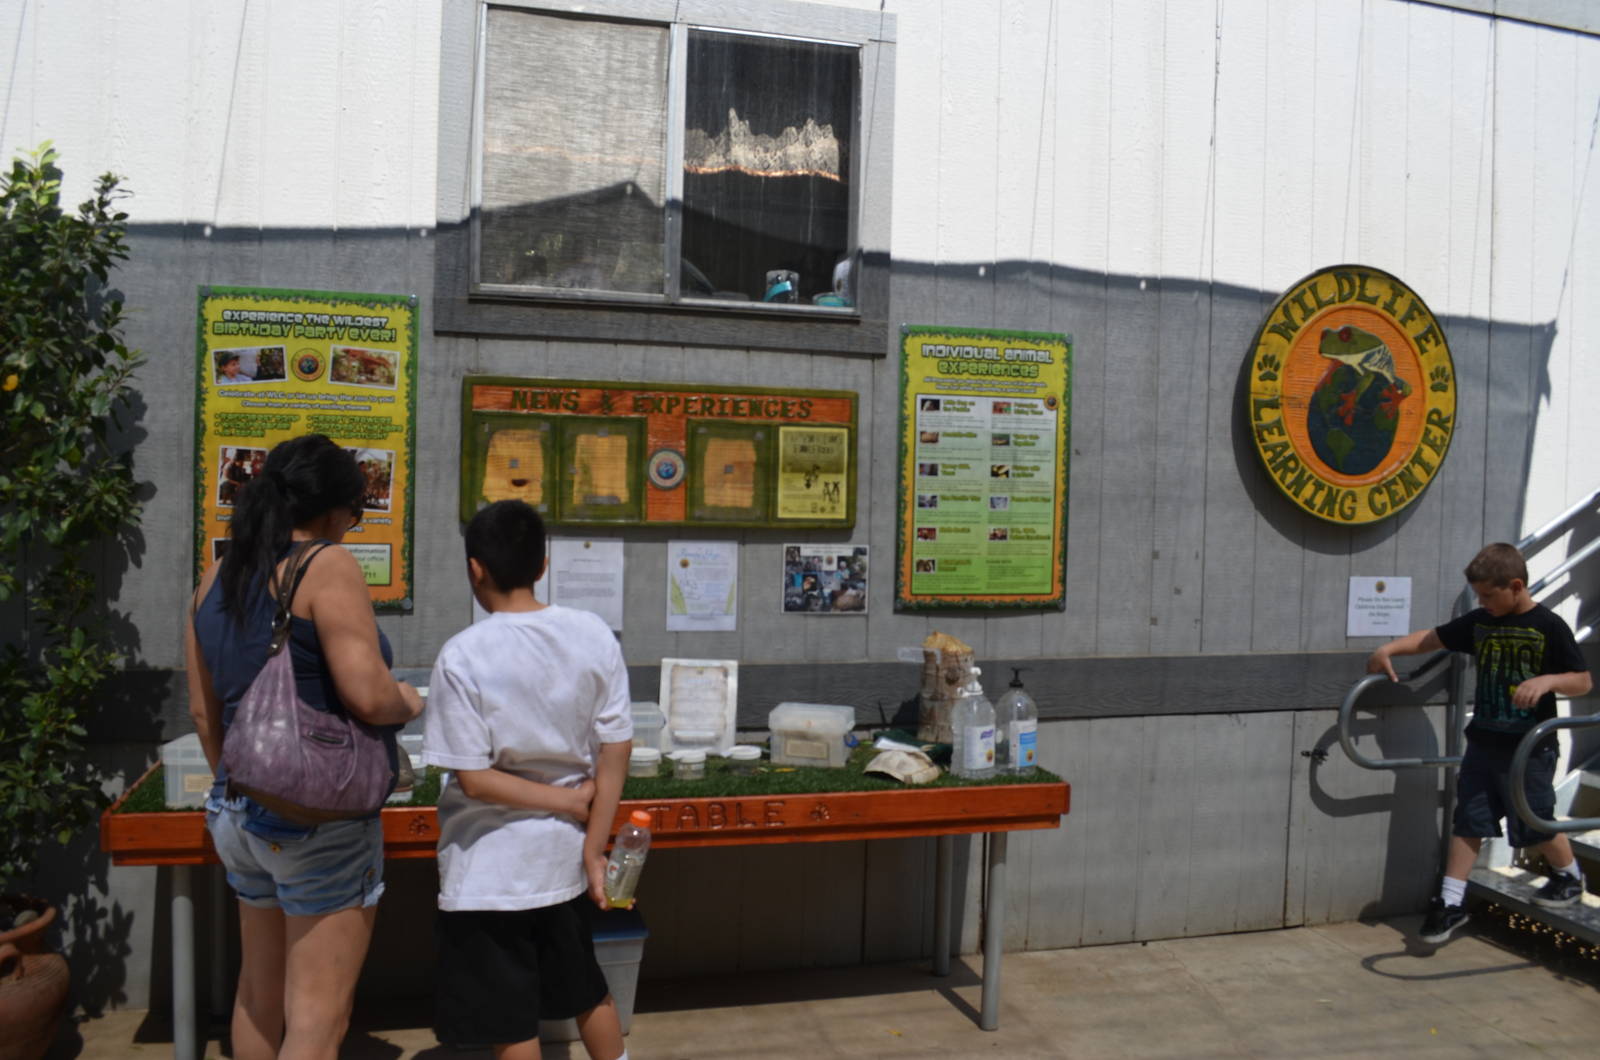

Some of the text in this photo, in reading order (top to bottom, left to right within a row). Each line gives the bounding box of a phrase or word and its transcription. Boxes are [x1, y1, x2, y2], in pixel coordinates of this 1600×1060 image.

[1267, 272, 1441, 355] WILDLIFE
[213, 322, 293, 337] BIRTHDAY
[294, 324, 346, 339] PARTY
[938, 360, 1039, 378] EXPERIENCES
[511, 389, 814, 419] NEWS & EXPERIENCES
[1253, 397, 1451, 520] LEARNING CENTER
[646, 800, 785, 831] TABLE
